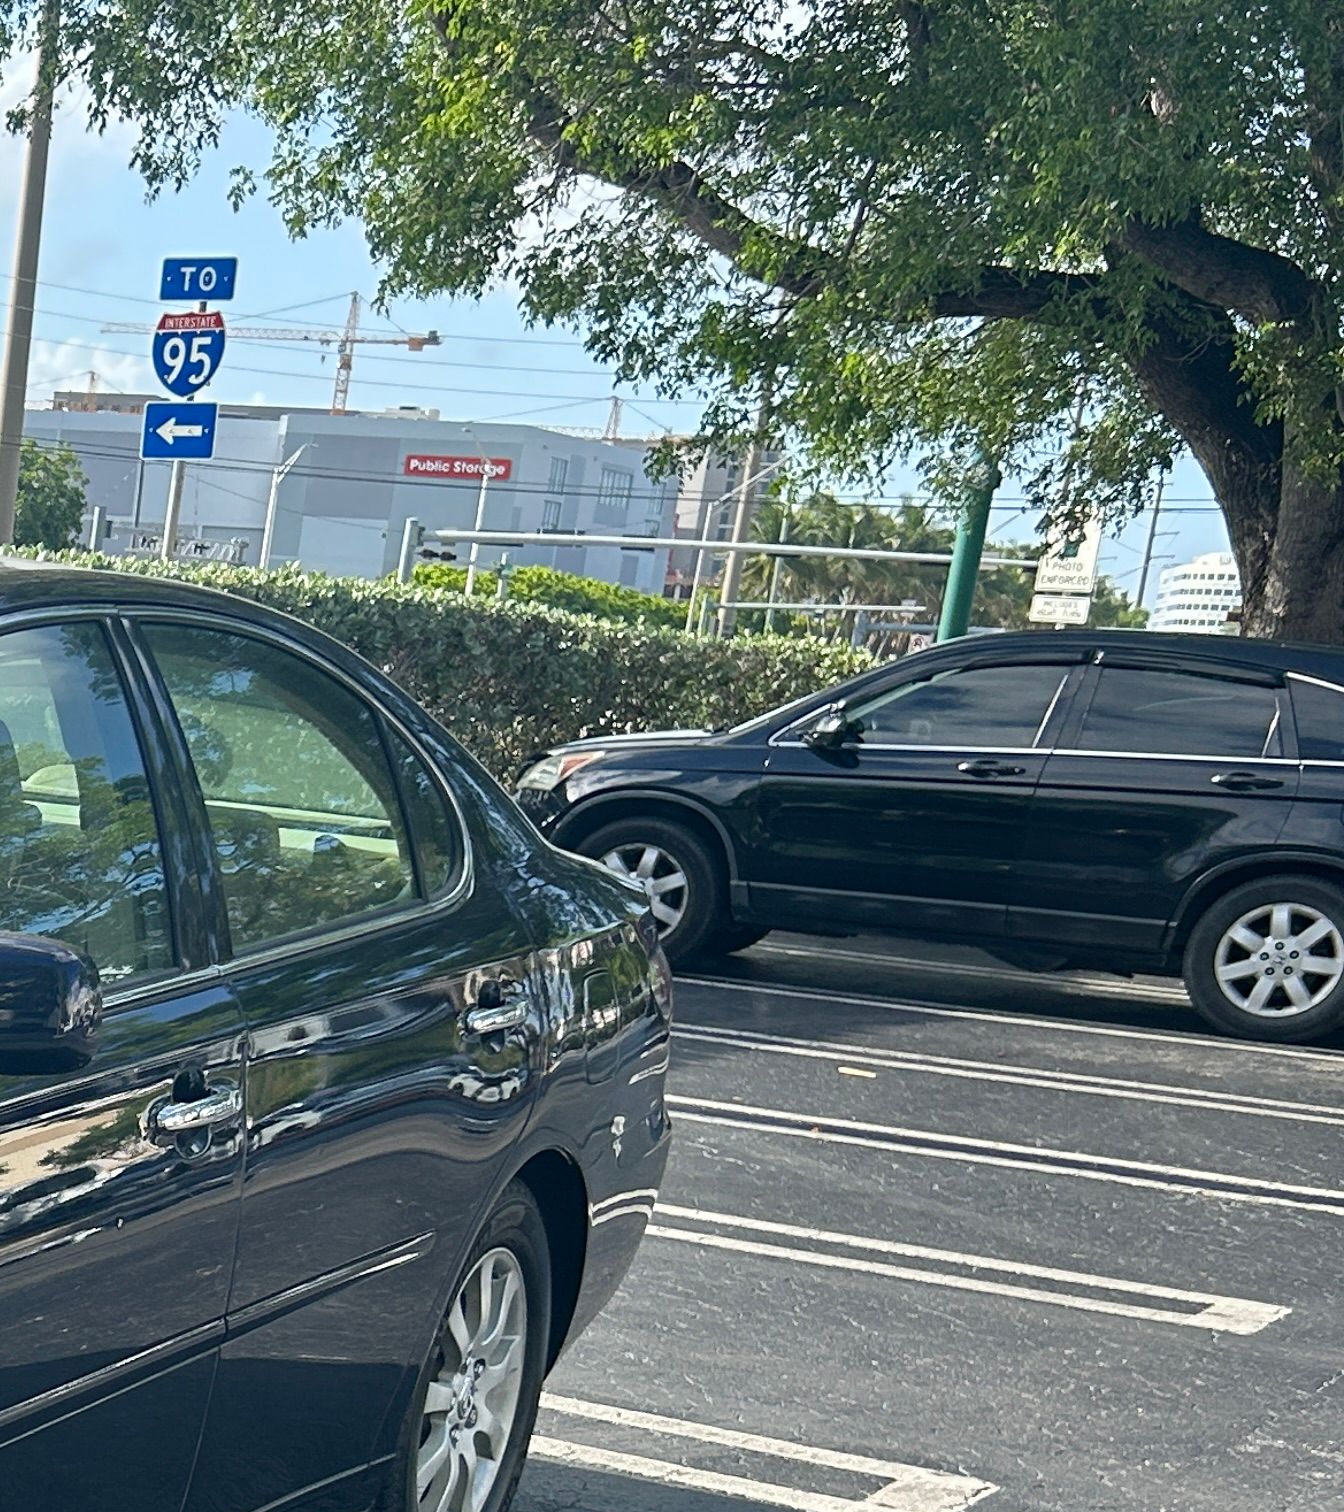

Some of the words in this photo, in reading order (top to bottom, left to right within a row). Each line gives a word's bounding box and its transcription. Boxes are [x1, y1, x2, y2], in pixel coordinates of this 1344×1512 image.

[180, 266, 217, 292] TO
[164, 315, 217, 329] INTERSTATE
[162, 336, 212, 385] 95
[409, 459, 450, 473] Public
[1052, 562, 1084, 572] PHOTO
[1040, 574, 1090, 586] ENFORCED
